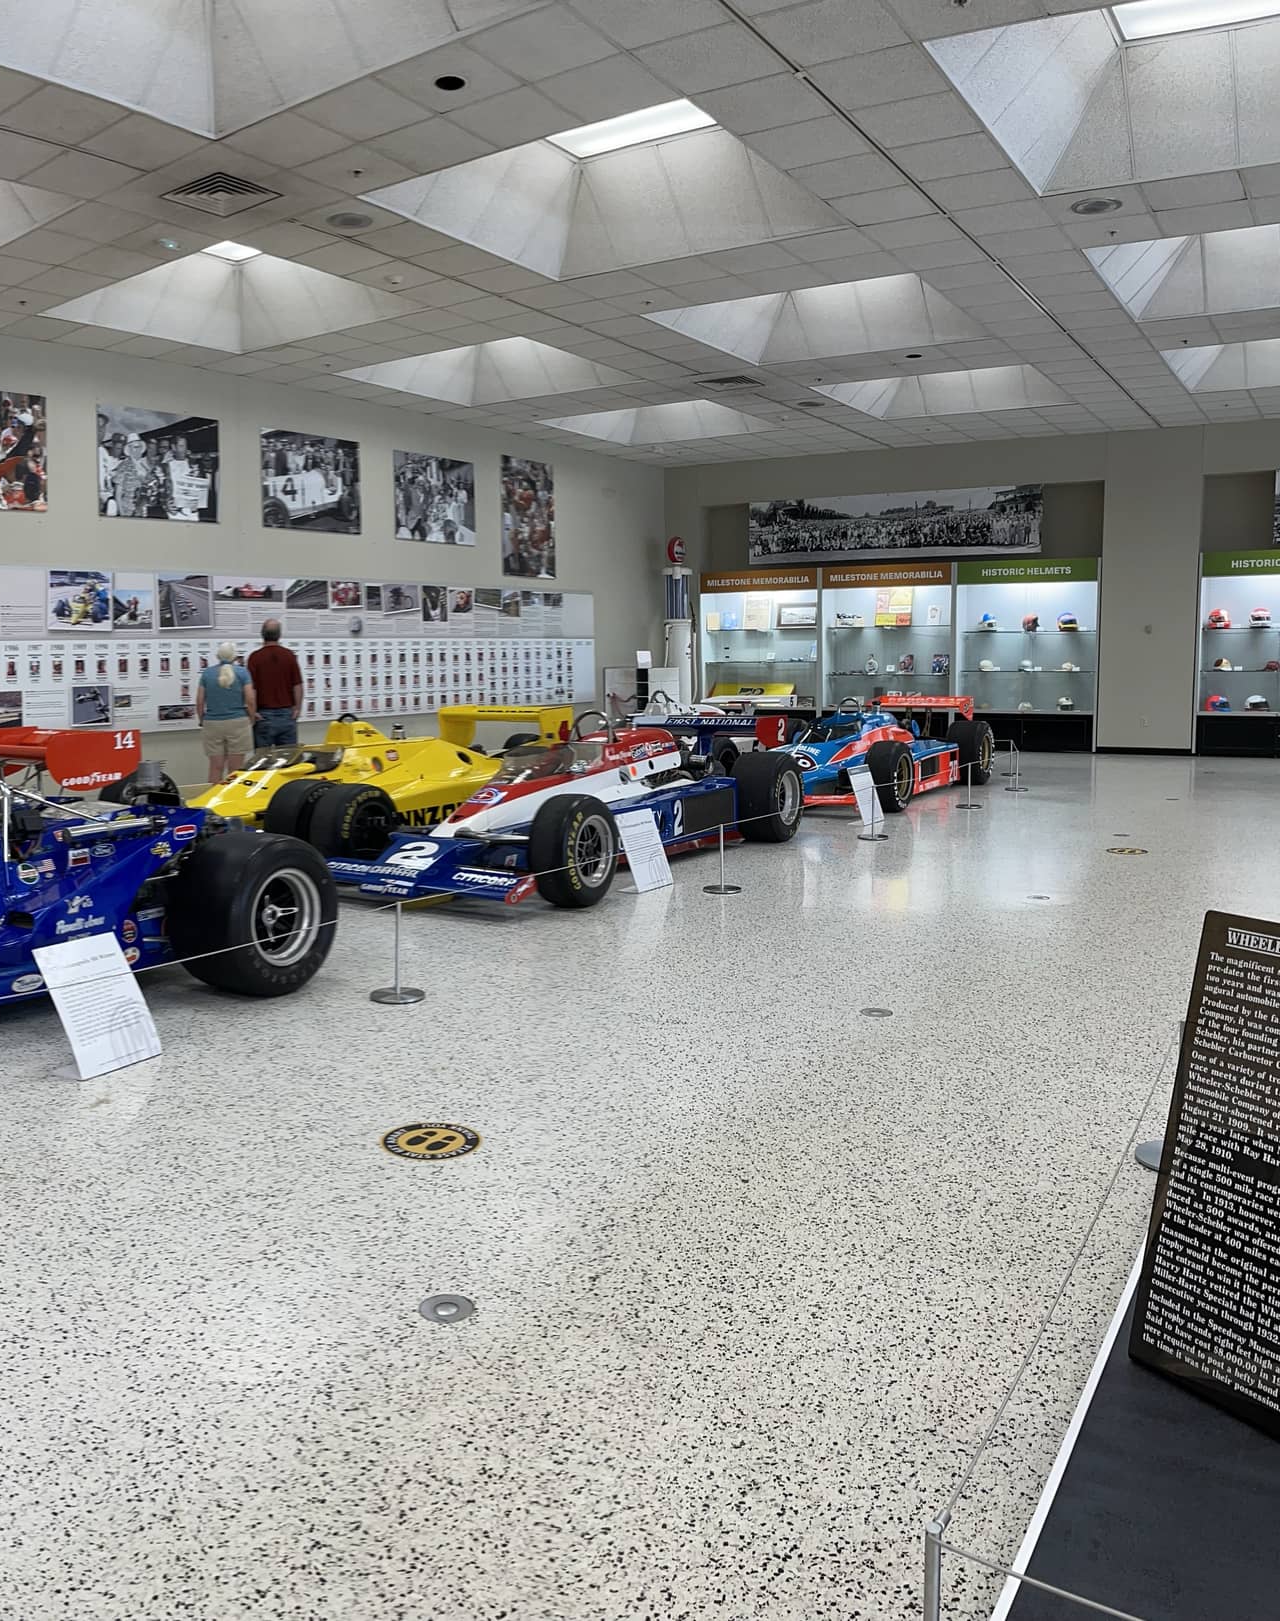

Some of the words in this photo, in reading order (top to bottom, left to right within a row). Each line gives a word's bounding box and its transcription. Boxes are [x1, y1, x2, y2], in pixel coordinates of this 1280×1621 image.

[706, 579, 751, 587] MILESTONE
[752, 576, 809, 585] MEMORABILIA
[830, 573, 879, 582] MILESTONE
[880, 570, 943, 581] MEMORABILIA
[981, 567, 1025, 577] HISTORIC
[1027, 566, 1071, 576] HELMETS
[666, 718, 697, 726] FIRST
[700, 717, 754, 726] NATIONAL
[777, 718, 785, 741] 2
[113, 731, 136, 750] 14
[673, 799, 683, 836] 2
[385, 841, 440, 870] 2
[451, 872, 518, 887] CITICORP
[1207, 963, 1244, 978] pre-dates
[1246, 971, 1261, 982] the
[1209, 951, 1224, 962] The
[1226, 957, 1274, 974] magnificent
[1203, 984, 1234, 997] augural
[1201, 995, 1239, 1013] Produced
[1241, 1005, 1252, 1017] by
[1253, 1009, 1268, 1020] the
[1195, 1026, 1230, 1044] Schebler,
[1232, 1035, 1245, 1047] his
[1192, 1036, 1226, 1053] Schebler
[1228, 1046, 1274, 1067] Carburetor
[1188, 1069, 1262, 1101] Wheeler-Schebler
[1181, 1101, 1210, 1118] August
[1211, 1111, 1224, 1124] 21,
[1227, 1116, 1251, 1133] 1909.
[1256, 1126, 1264, 1137] It
[1176, 1132, 1193, 1146] May
[1194, 1139, 1208, 1152] 28,
[1210, 1145, 1234, 1161] 1910.
[1173, 1145, 1206, 1165] Because
[1207, 1161, 1254, 1184] multi-event
[1165, 1197, 1232, 1233] Wheeler-Schebler
[1233, 1229, 1249, 1241] was
[1154, 1254, 1180, 1273] Harry
[1181, 1266, 1207, 1285] Hartz
[1209, 1281, 1240, 1301] retired
[1242, 1295, 1257, 1309] the
[1151, 1277, 1195, 1303] consecutive
[1195, 1299, 1218, 1315] years
[1220, 1309, 1254, 1332] through
[1256, 1326, 1280, 1345] 1932.
[1145, 1310, 1163, 1326] Said
[1164, 1320, 1173, 1331] to
[1174, 1324, 1192, 1341] have
[1194, 1337, 1211, 1351] cost
[1213, 1345, 1257, 1374] $8,000.00
[1259, 1368, 1268, 1381] in
[1142, 1332, 1155, 1345] the
[1156, 1339, 1174, 1355] time
[1175, 1348, 1182, 1359] it
[1184, 1355, 1199, 1368] was
[1200, 1362, 1209, 1374] in
[1211, 1368, 1232, 1385] their
[1233, 1382, 1280, 1412] possession.
